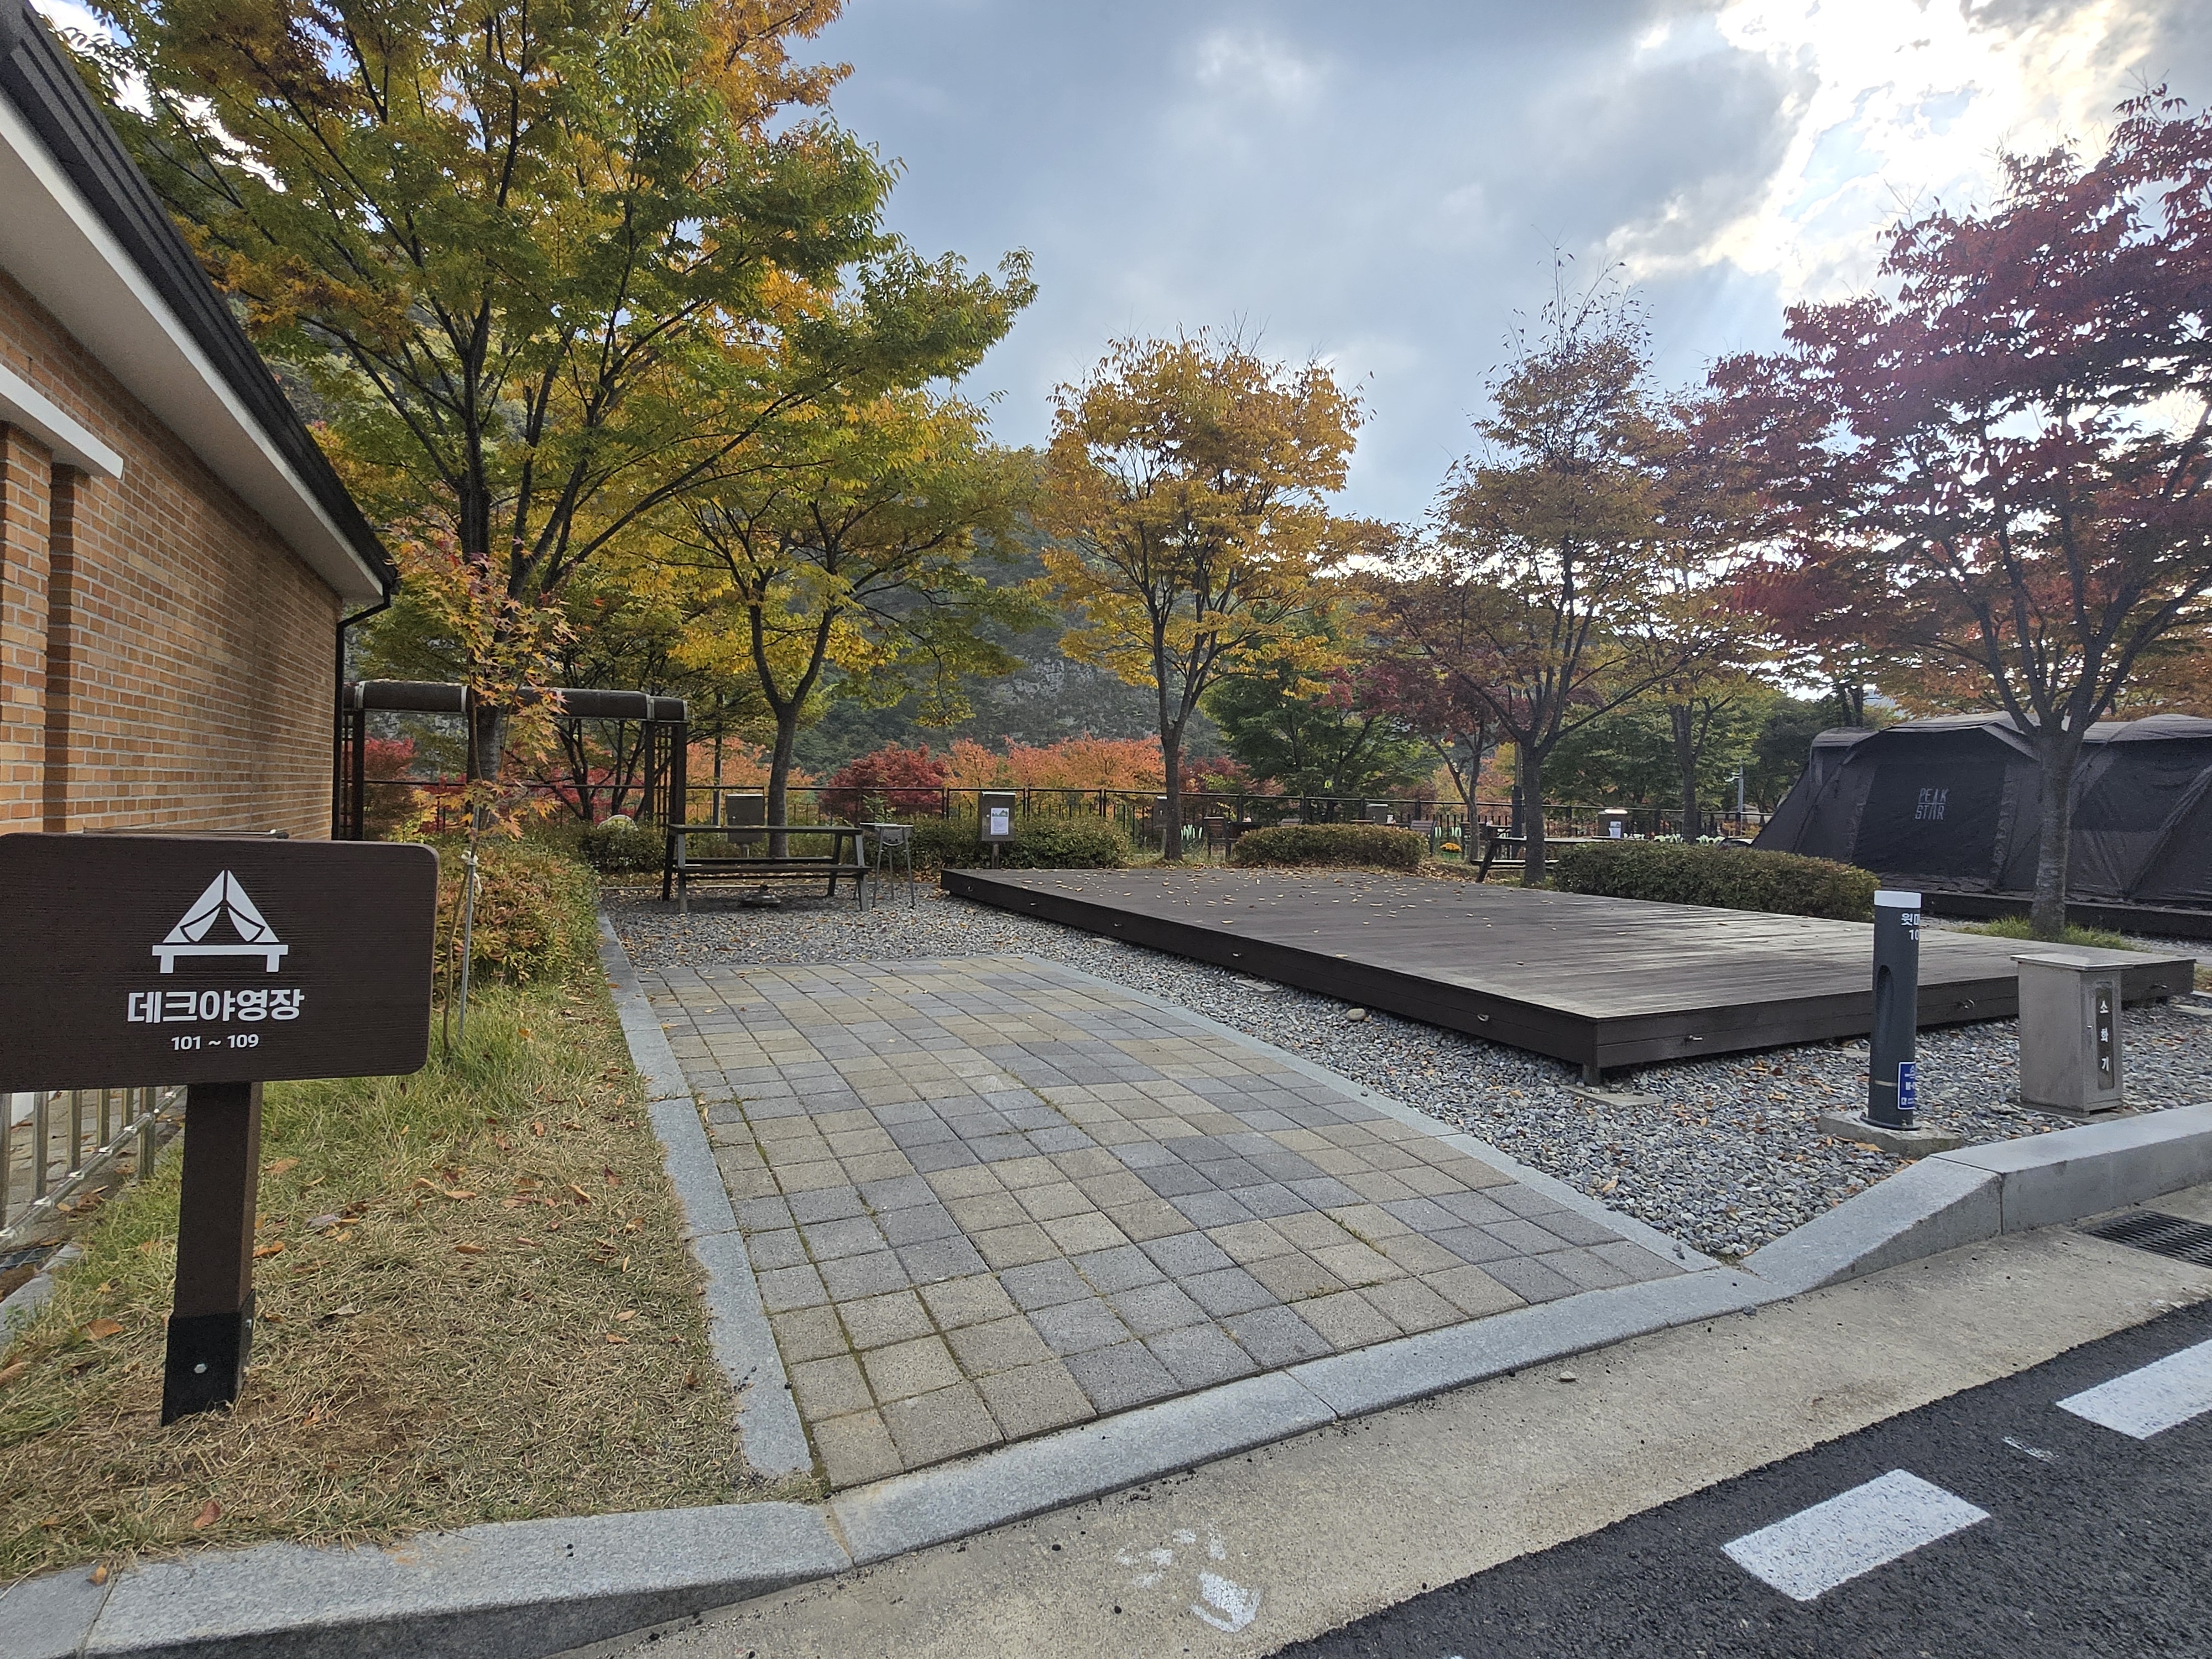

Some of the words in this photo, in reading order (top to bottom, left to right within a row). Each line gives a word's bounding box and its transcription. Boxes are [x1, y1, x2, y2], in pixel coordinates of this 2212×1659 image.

[1918, 787, 1948, 802] PEAK
[127, 989, 305, 1023] 데크야영장
[171, 1036, 201, 1050] 101
[227, 1034, 259, 1048] 109
[2100, 1000, 2109, 1072] 소화기
